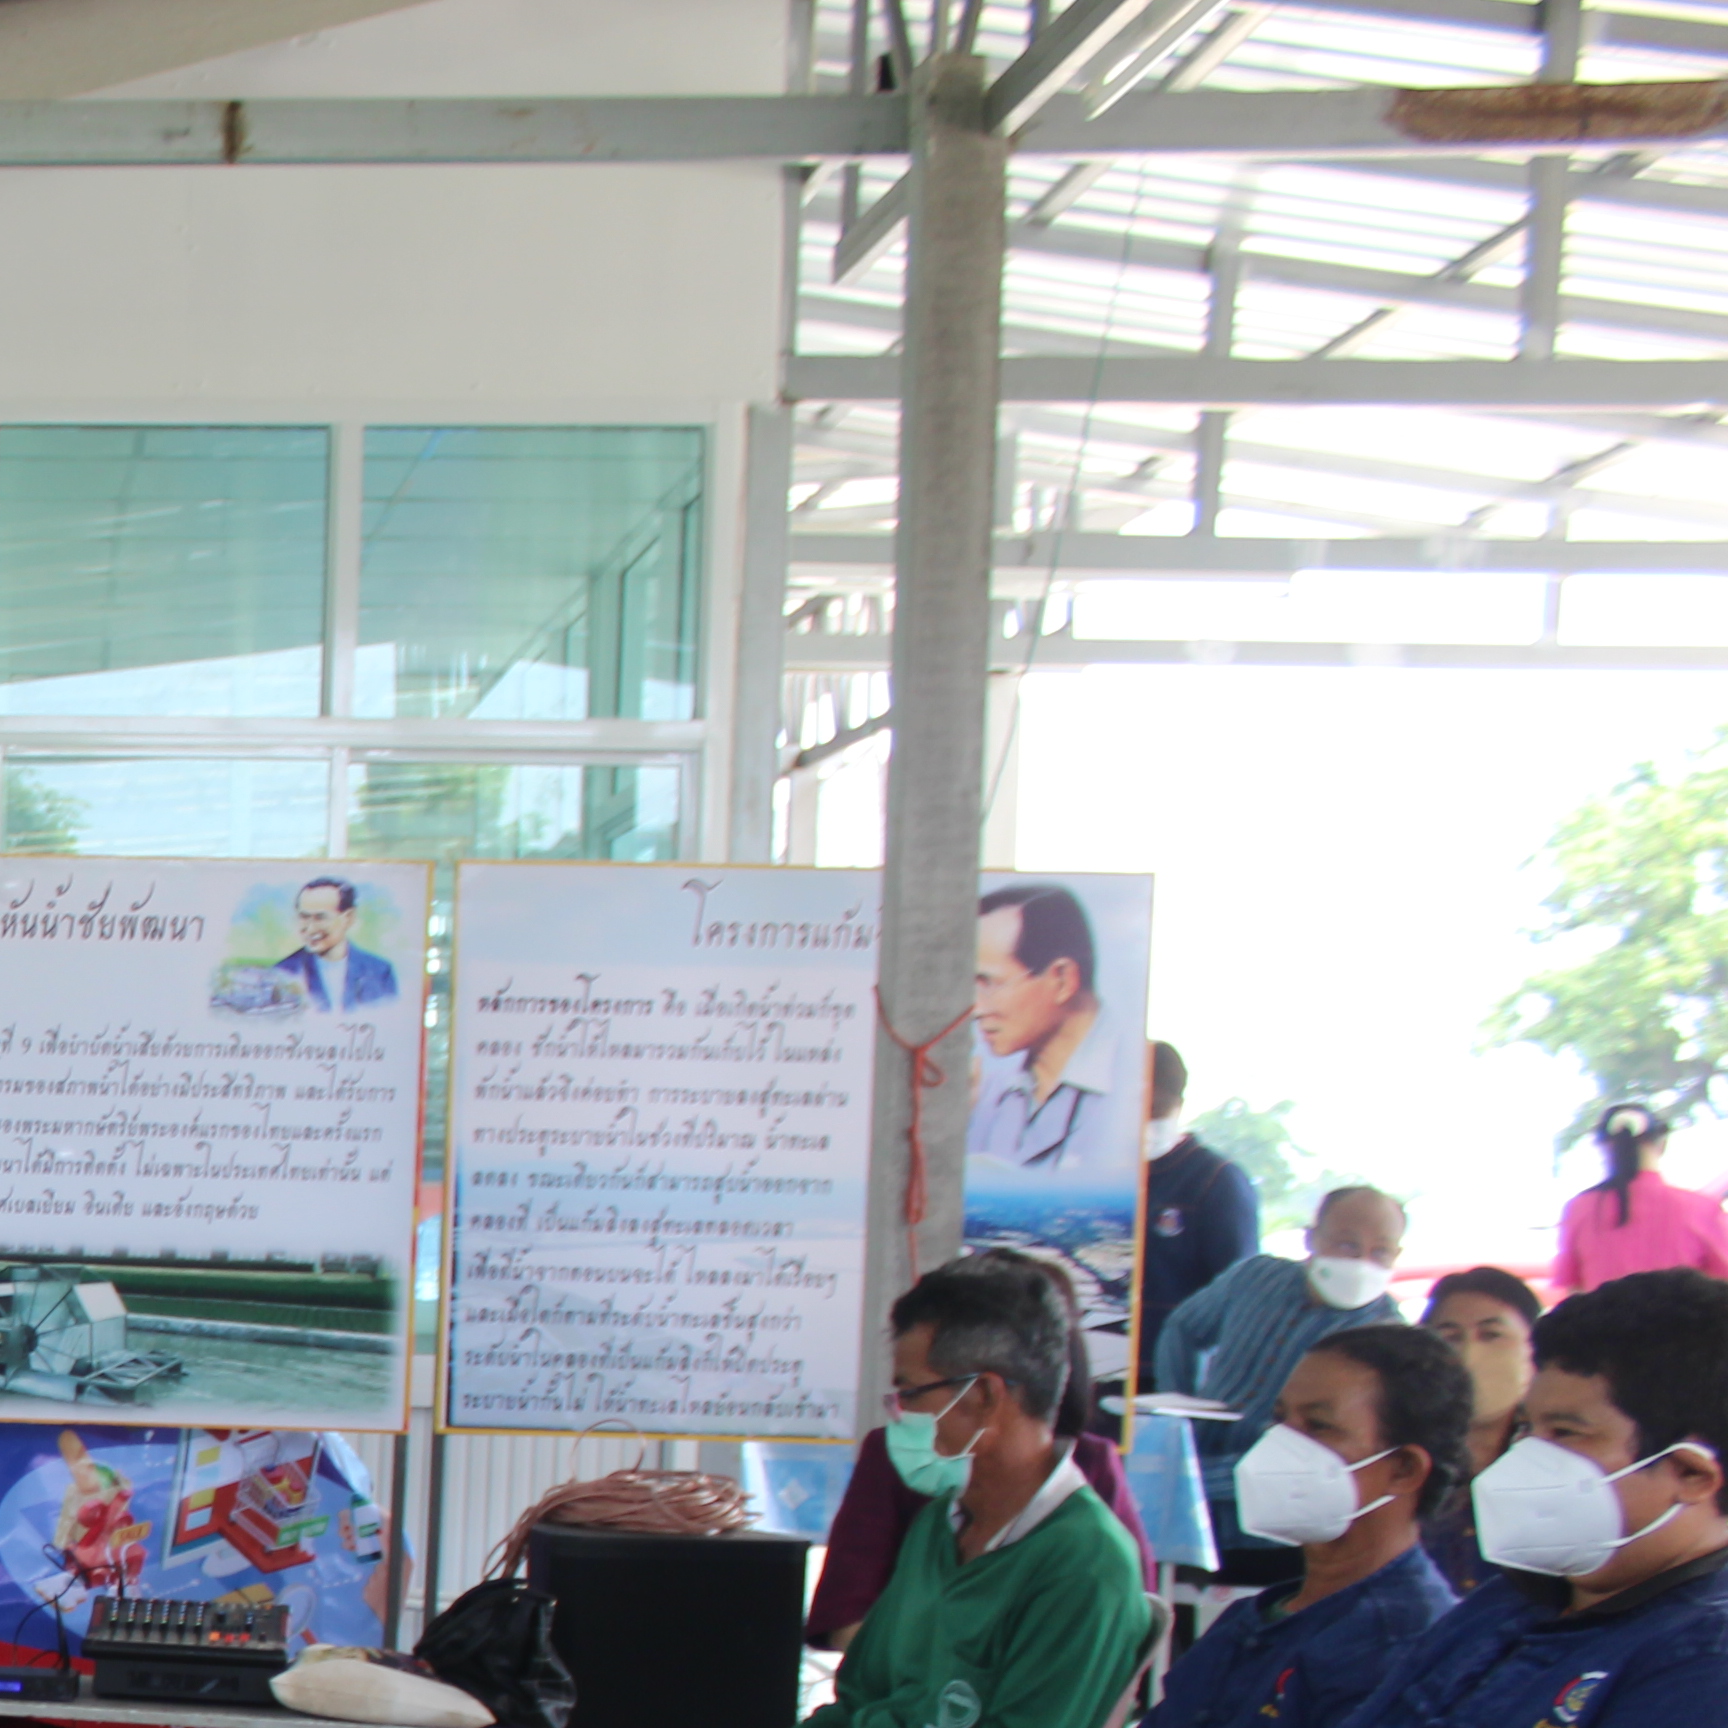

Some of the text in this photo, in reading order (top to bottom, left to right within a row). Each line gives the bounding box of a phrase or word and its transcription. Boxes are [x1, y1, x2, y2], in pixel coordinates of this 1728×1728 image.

[680, 878, 882, 951] โครงการแก้ม
